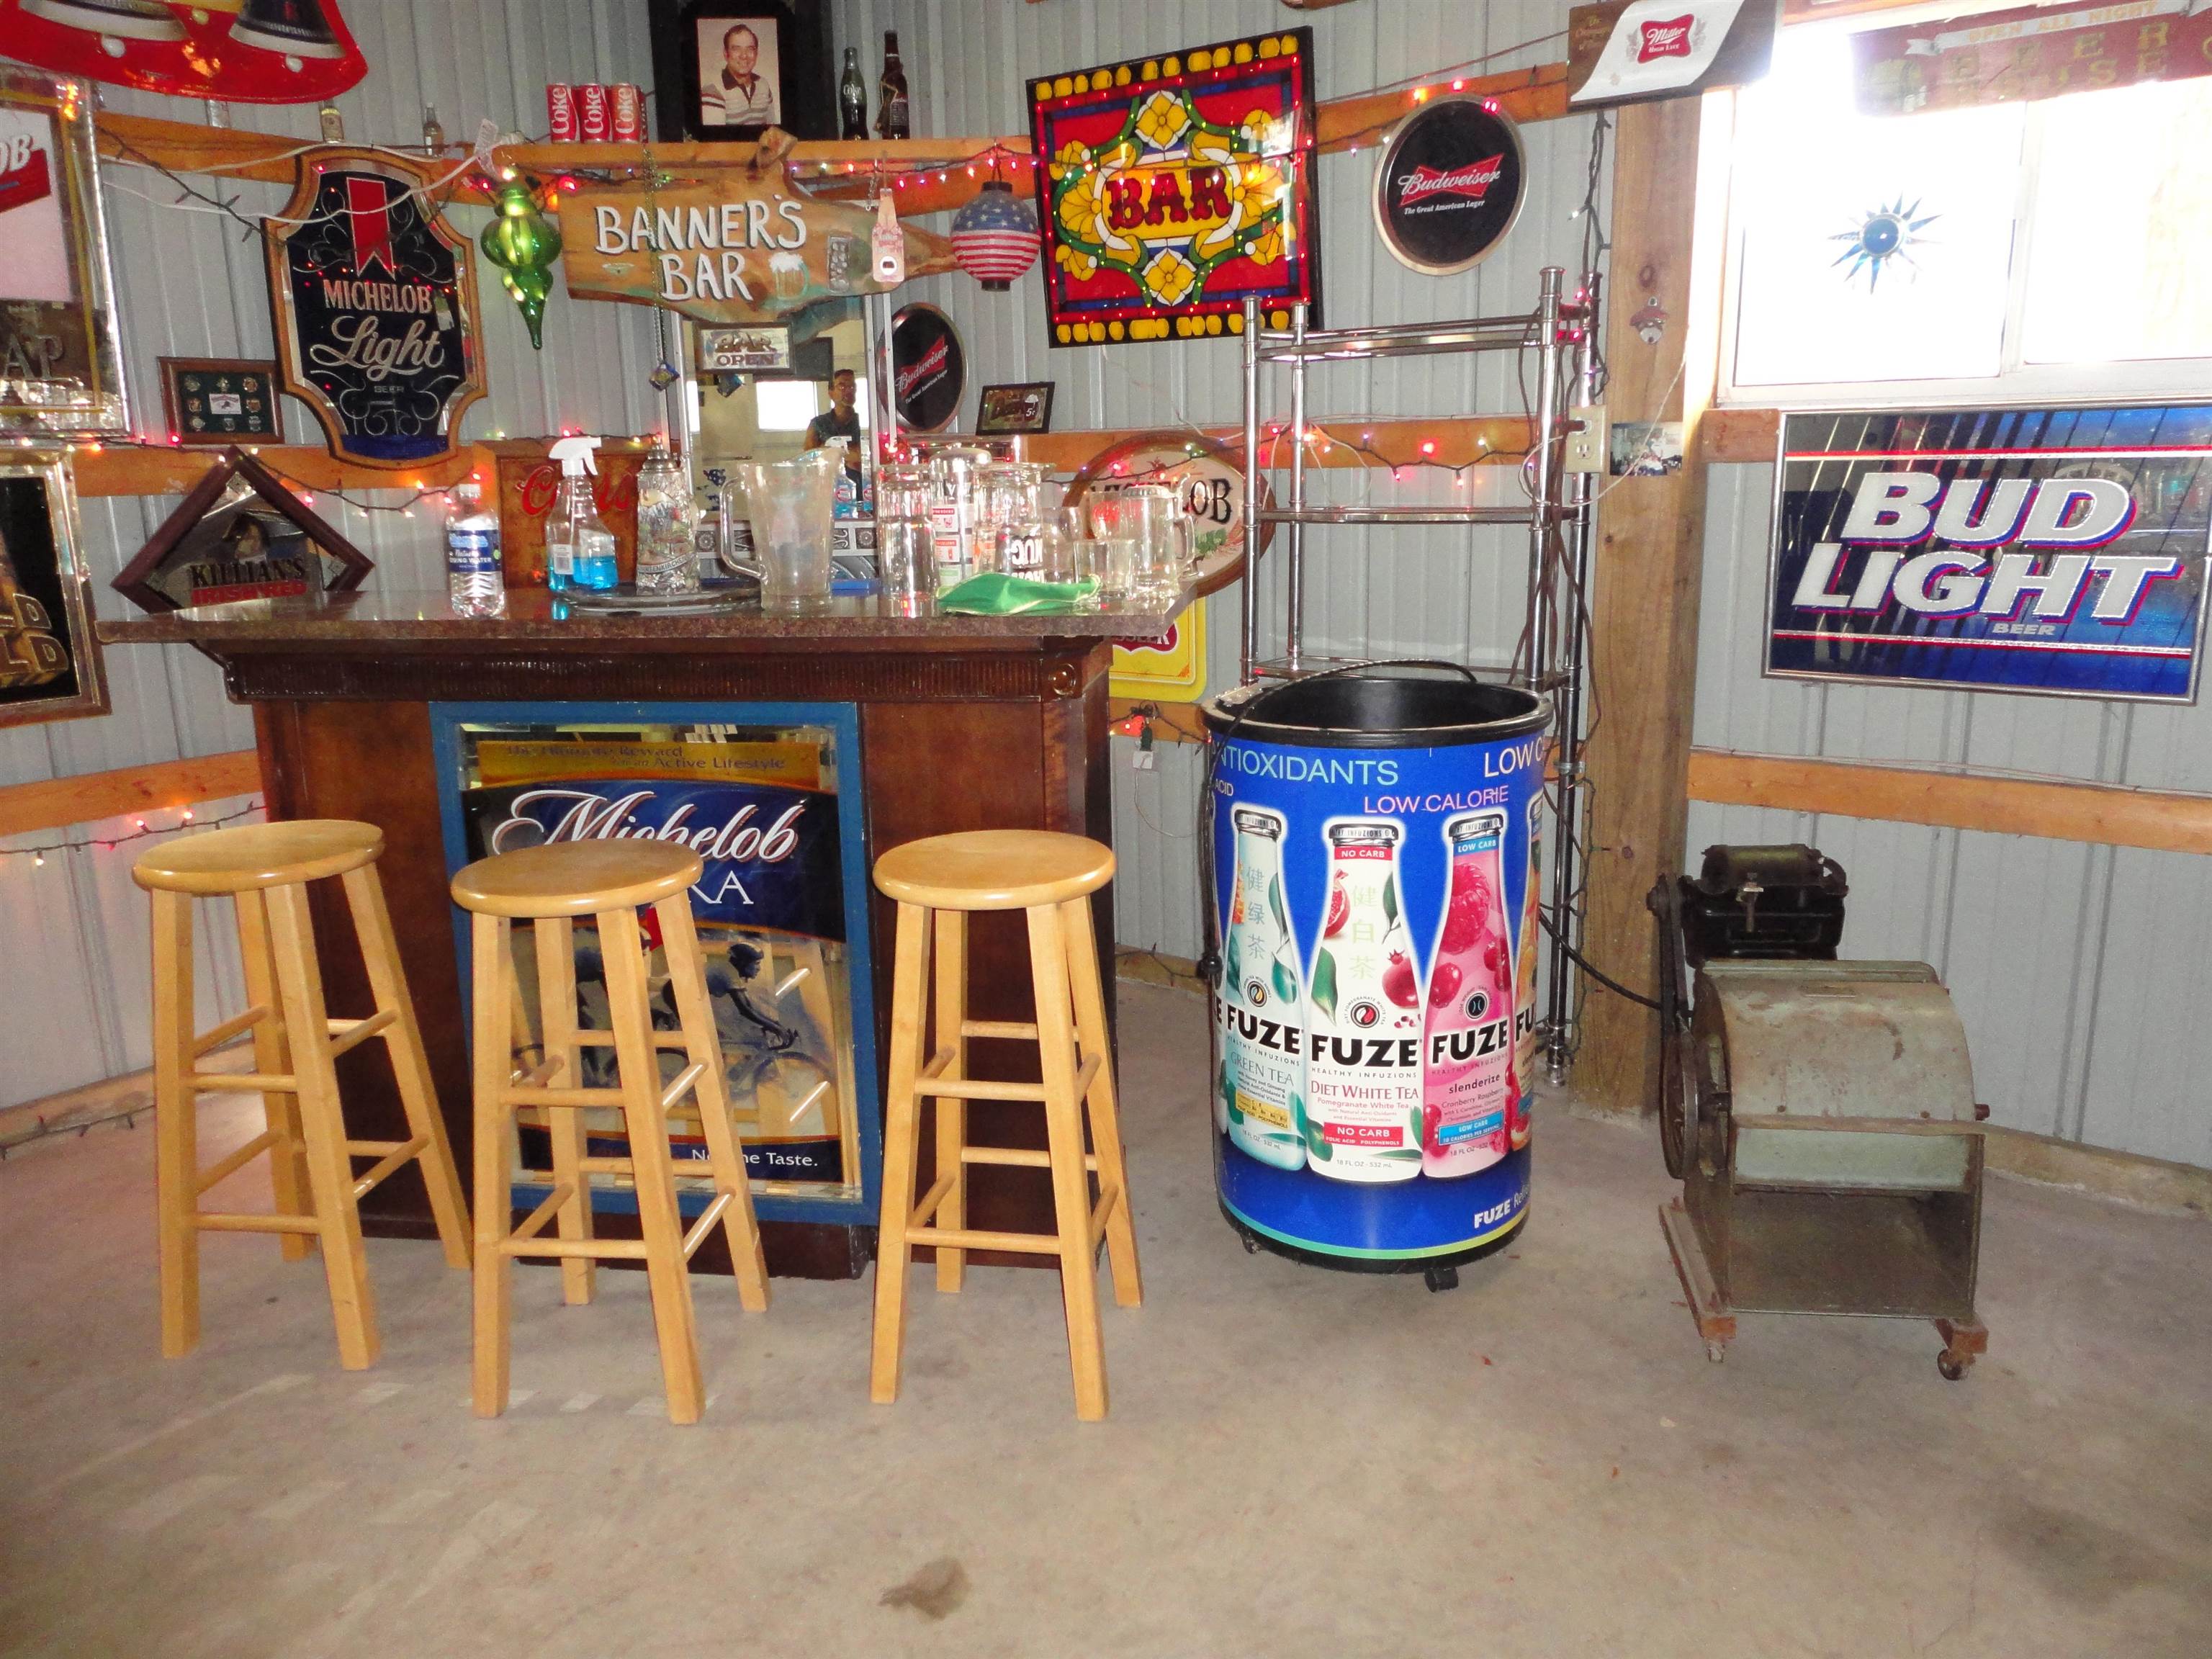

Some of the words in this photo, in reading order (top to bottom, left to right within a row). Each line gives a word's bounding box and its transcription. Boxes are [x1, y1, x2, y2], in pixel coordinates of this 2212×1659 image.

[1646, 27, 1686, 45] Miller
[843, 83, 862, 96] Coke
[552, 87, 569, 134] Coke
[584, 87, 603, 134] Coke
[615, 87, 634, 134] Coke
[1398, 170, 1501, 195] Budweiser
[1106, 167, 1233, 230] BAR
[1416, 204, 1434, 214] Great
[1434, 201, 1465, 212] American
[1466, 199, 1485, 209] Lager
[595, 194, 806, 254] BANNER'S
[659, 251, 753, 301] BAR
[323, 279, 432, 314] MICHELOB
[310, 315, 444, 382] Light
[716, 354, 775, 367] OPEN
[894, 346, 949, 392] Budweiser
[514, 465, 632, 517] Crs
[1840, 472, 2137, 549] BUD
[1792, 543, 2185, 626] LIGHT
[1992, 624, 2055, 635] BEER
[656, 757, 706, 768] Active
[1485, 744, 1533, 778] LOW
[1364, 795, 1421, 814] LOW
[1424, 784, 1509, 813] CALORIE
[1359, 849, 1385, 858] CARB
[1458, 843, 1476, 853] LOW
[1478, 840, 1496, 848] CARB
[1227, 1004, 1300, 1055] FUZE
[1432, 1019, 1509, 1064] FUZE
[1255, 1048, 1300, 1066] INFUZIONS
[1311, 1034, 1418, 1067] FUZE
[1231, 1051, 1264, 1078] GREEN
[1267, 1067, 1295, 1087] TEA
[1311, 1067, 1352, 1077] HEALTHY
[1449, 1073, 1501, 1094] slenderize
[1311, 1080, 1339, 1097] DIET
[1342, 1084, 1393, 1100] WHITE
[1395, 1087, 1419, 1100] TEA
[1318, 1097, 1367, 1108] Pomegranate
[1442, 1097, 1476, 1109] Cranberry
[1337, 1127, 1355, 1136] NO
[1359, 1128, 1390, 1137] CARB
[1459, 1123, 1473, 1133] LOW
[766, 1152, 818, 1166] Taste.
[1474, 1198, 1511, 1229] FUZE
